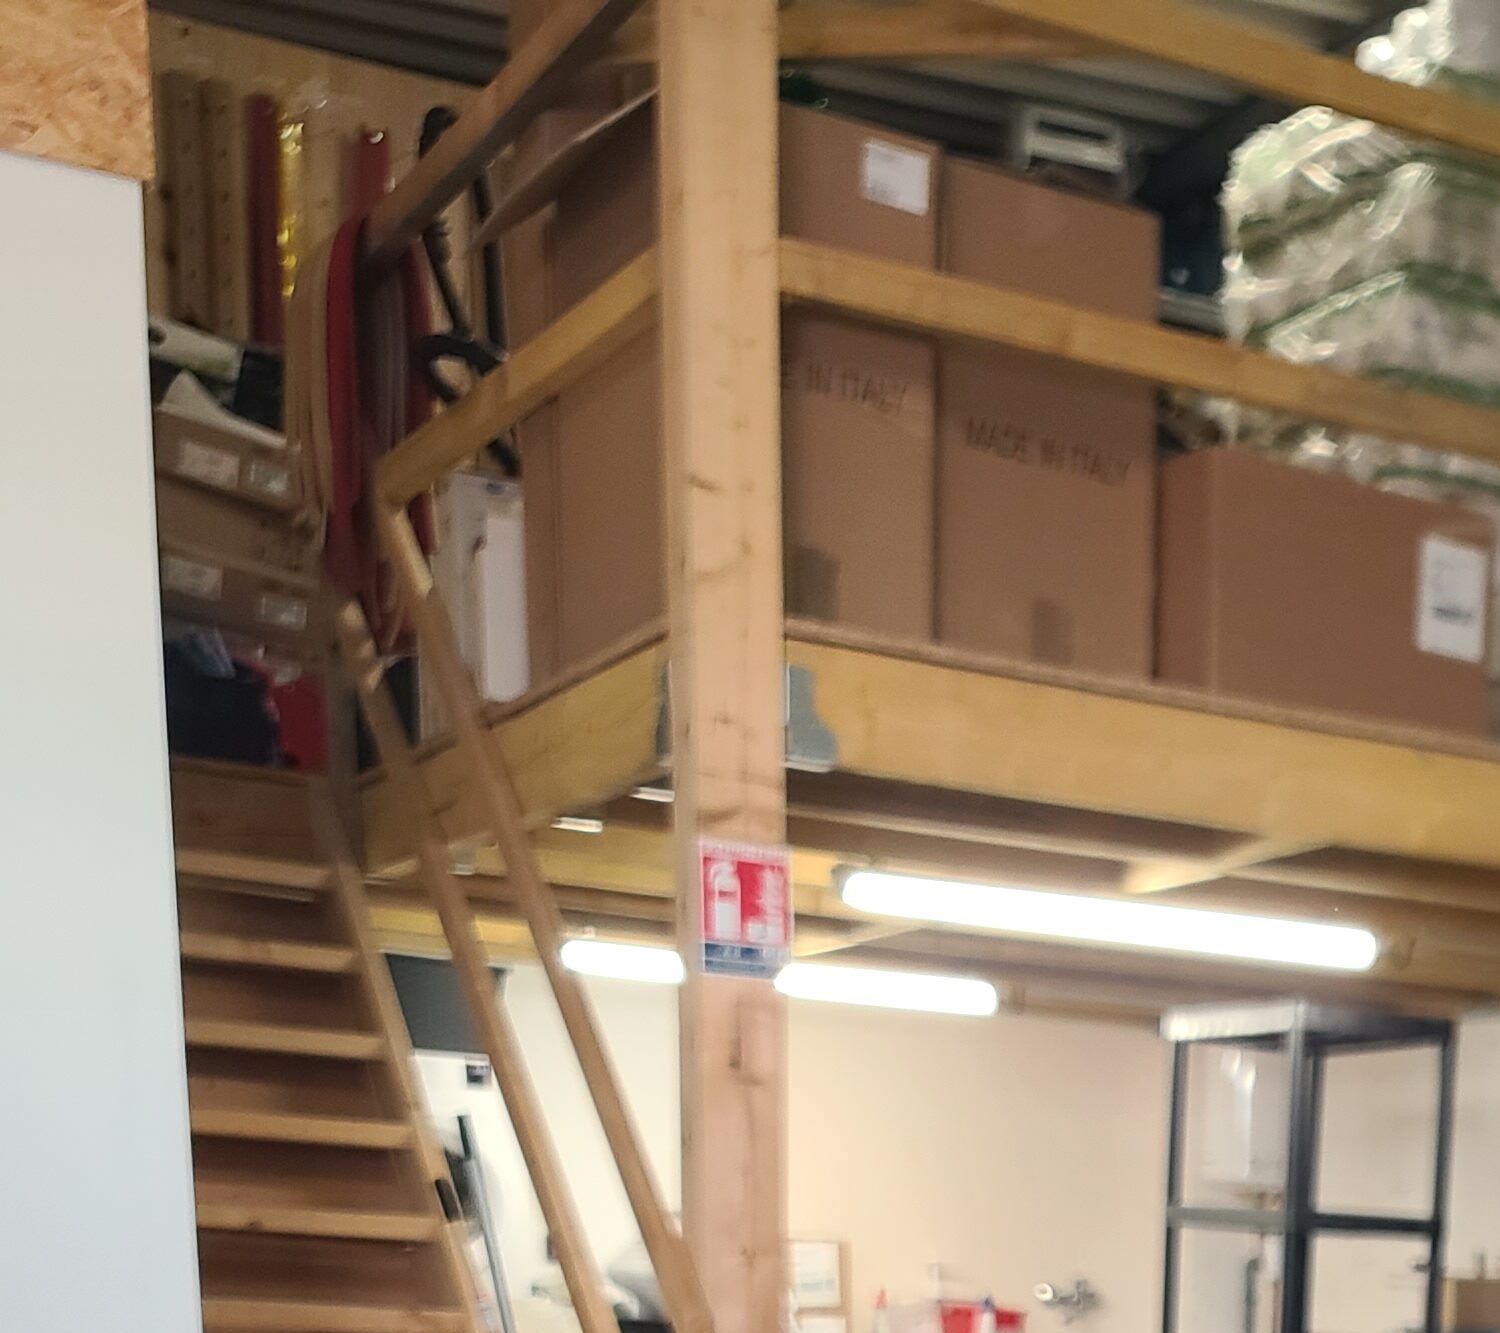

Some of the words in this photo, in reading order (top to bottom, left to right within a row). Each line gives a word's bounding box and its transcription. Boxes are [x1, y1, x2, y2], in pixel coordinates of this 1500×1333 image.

[807, 362, 832, 396] IN
[841, 366, 908, 415] ITALY
[965, 415, 1028, 464] MADE
[1040, 438, 1066, 472] IN
[1071, 446, 1133, 489] ITALY
